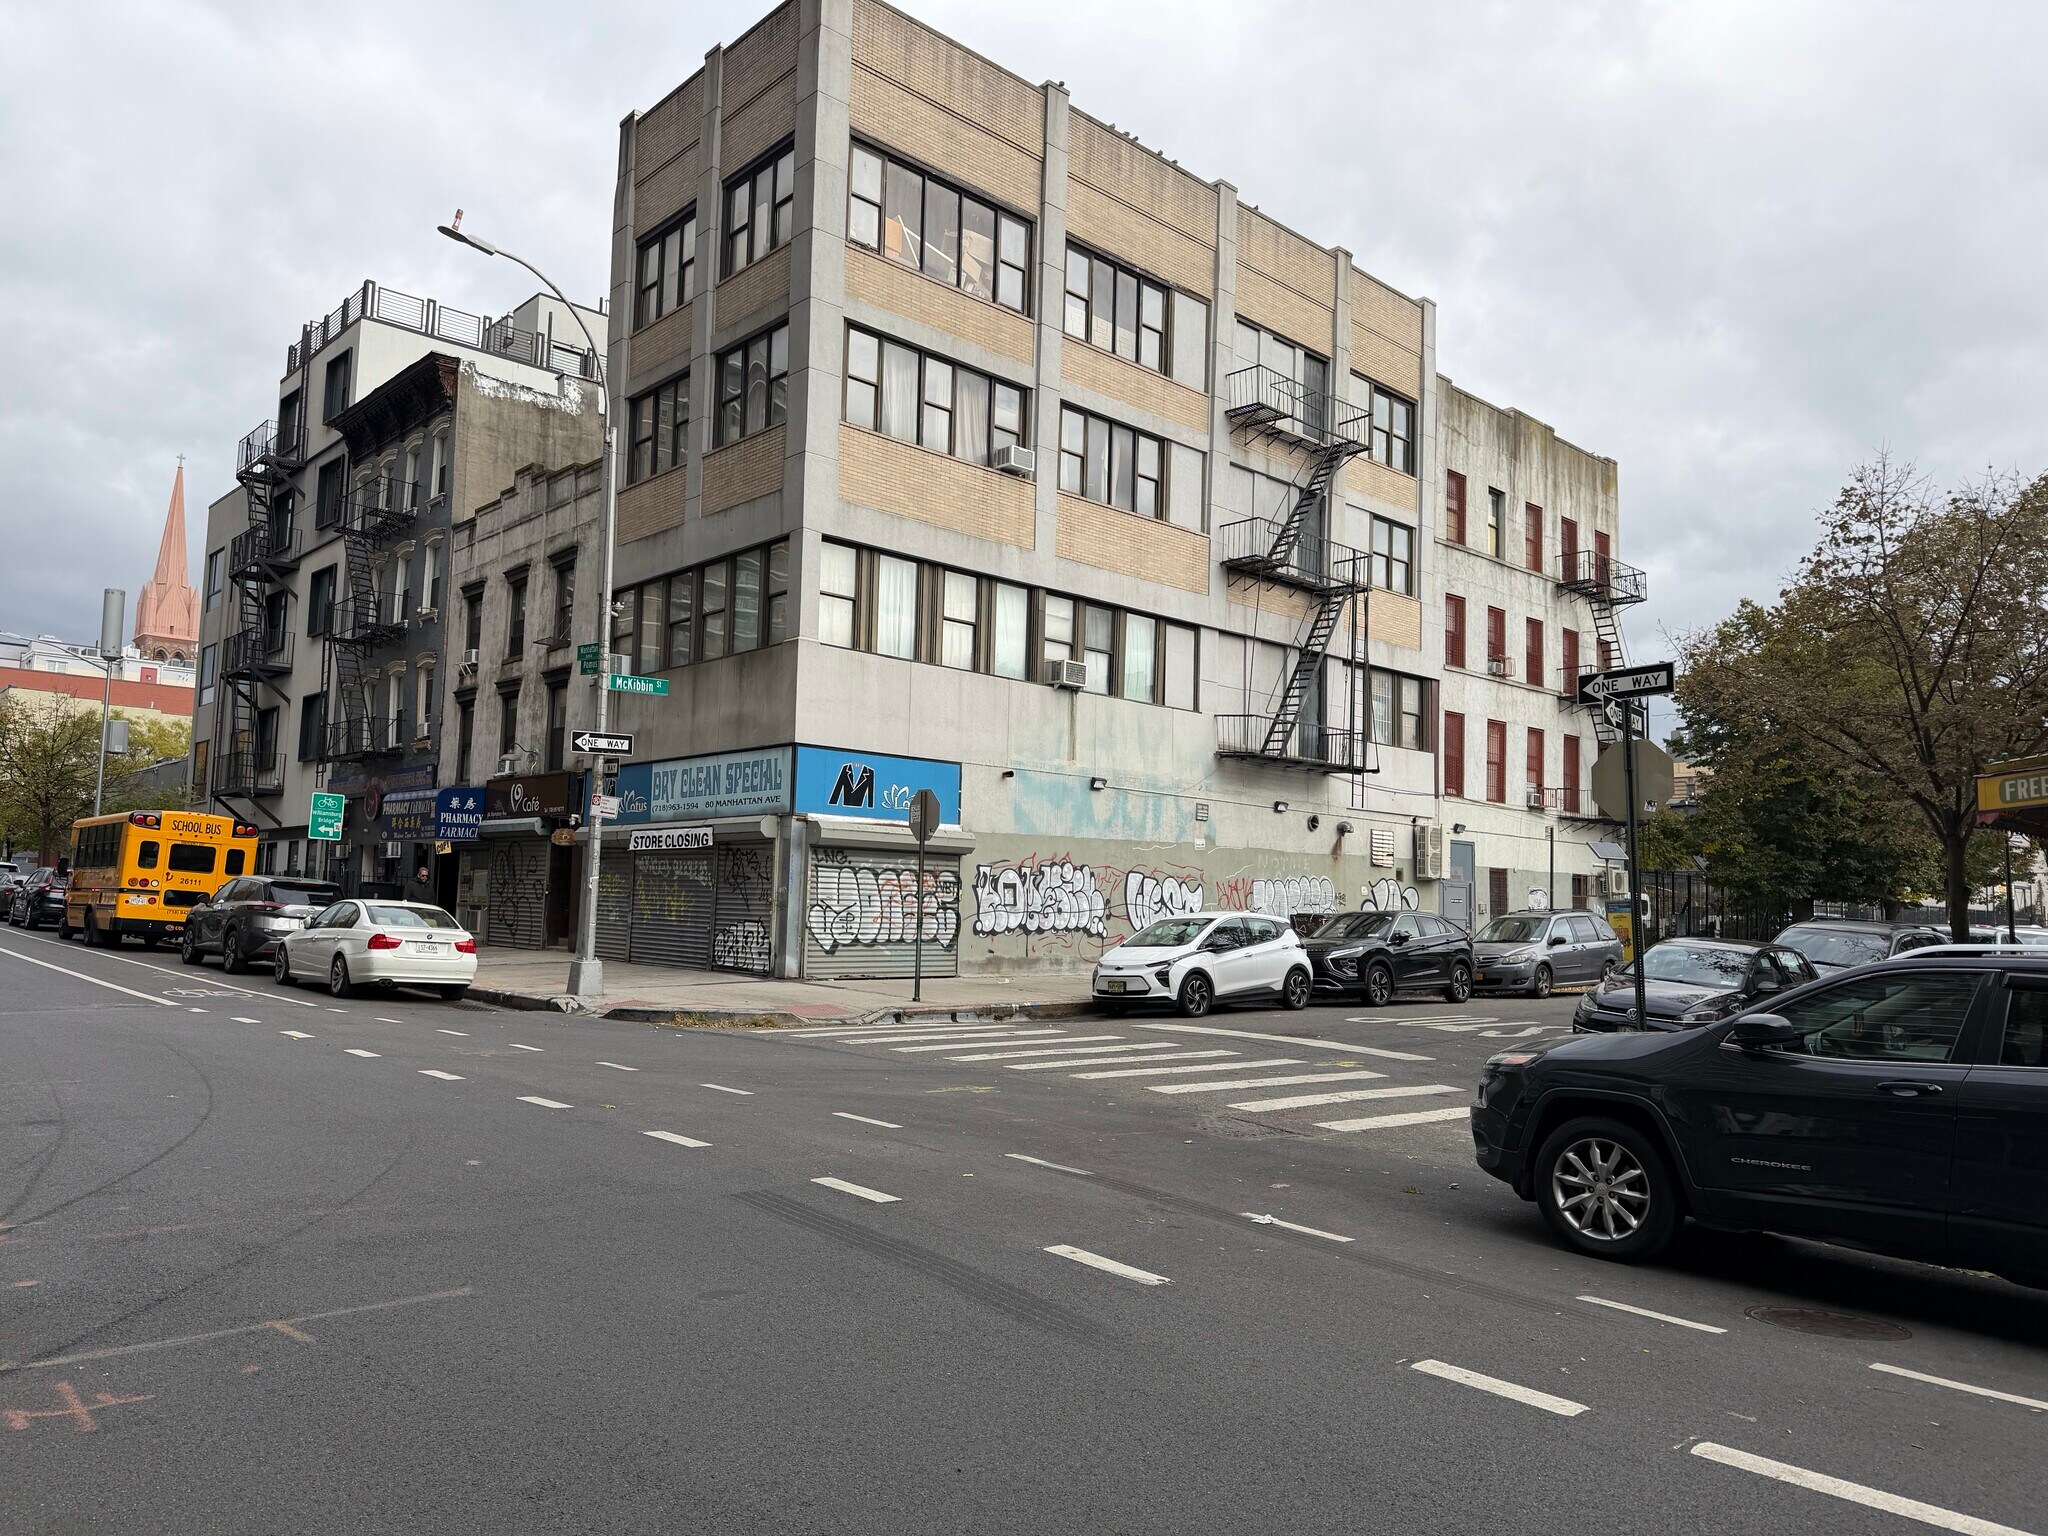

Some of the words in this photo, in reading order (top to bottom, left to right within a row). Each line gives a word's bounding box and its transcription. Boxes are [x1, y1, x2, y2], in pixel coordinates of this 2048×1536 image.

[616, 677, 654, 692] McKibbin
[1592, 679, 1619, 694] ONE
[1632, 673, 1661, 688] WAY
[1609, 708, 1622, 721] ONE
[581, 738, 599, 747] ONE
[607, 740, 625, 748] WAY
[652, 769, 678, 803] DRY
[680, 764, 722, 799] CLEAN
[725, 758, 782, 795] SPECIAL
[2005, 775, 2048, 801] FREE
[522, 796, 540, 812] Café
[652, 802, 699, 814] (718)963-1594
[715, 797, 763, 808] MANHATTAN
[765, 795, 781, 803] AVE
[312, 810, 342, 818] Williamsburg
[440, 812, 484, 826] PHARMACY
[172, 820, 203, 833] SCHOOL
[205, 824, 222, 835] BUS
[440, 826, 479, 838] FARMACI
[633, 835, 663, 849] STORE
[664, 833, 709, 848] CLOSING
[180, 878, 201, 886] 26111
[1731, 1157, 1811, 1171] CHEROKEE
